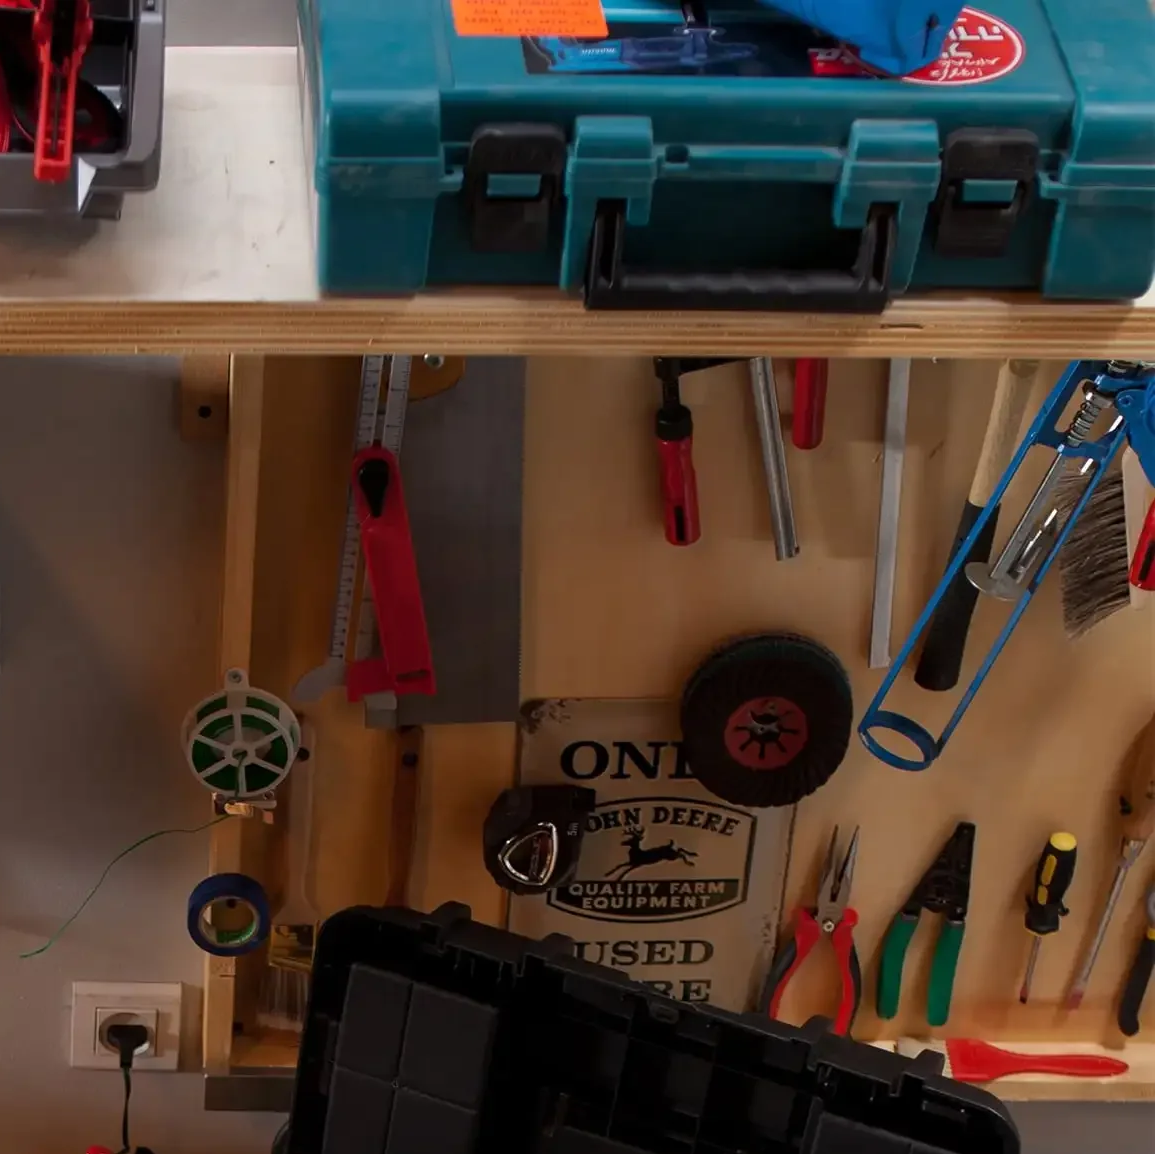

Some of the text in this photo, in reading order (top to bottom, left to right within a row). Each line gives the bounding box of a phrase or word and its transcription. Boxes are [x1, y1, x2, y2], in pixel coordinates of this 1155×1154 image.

[560, 740, 699, 780] ONL
[584, 806, 741, 837] OHN DEERE
[567, 881, 726, 897] QUALITY FARM
[581, 895, 711, 910] EQUIPMENT
[573, 940, 715, 967] USED
